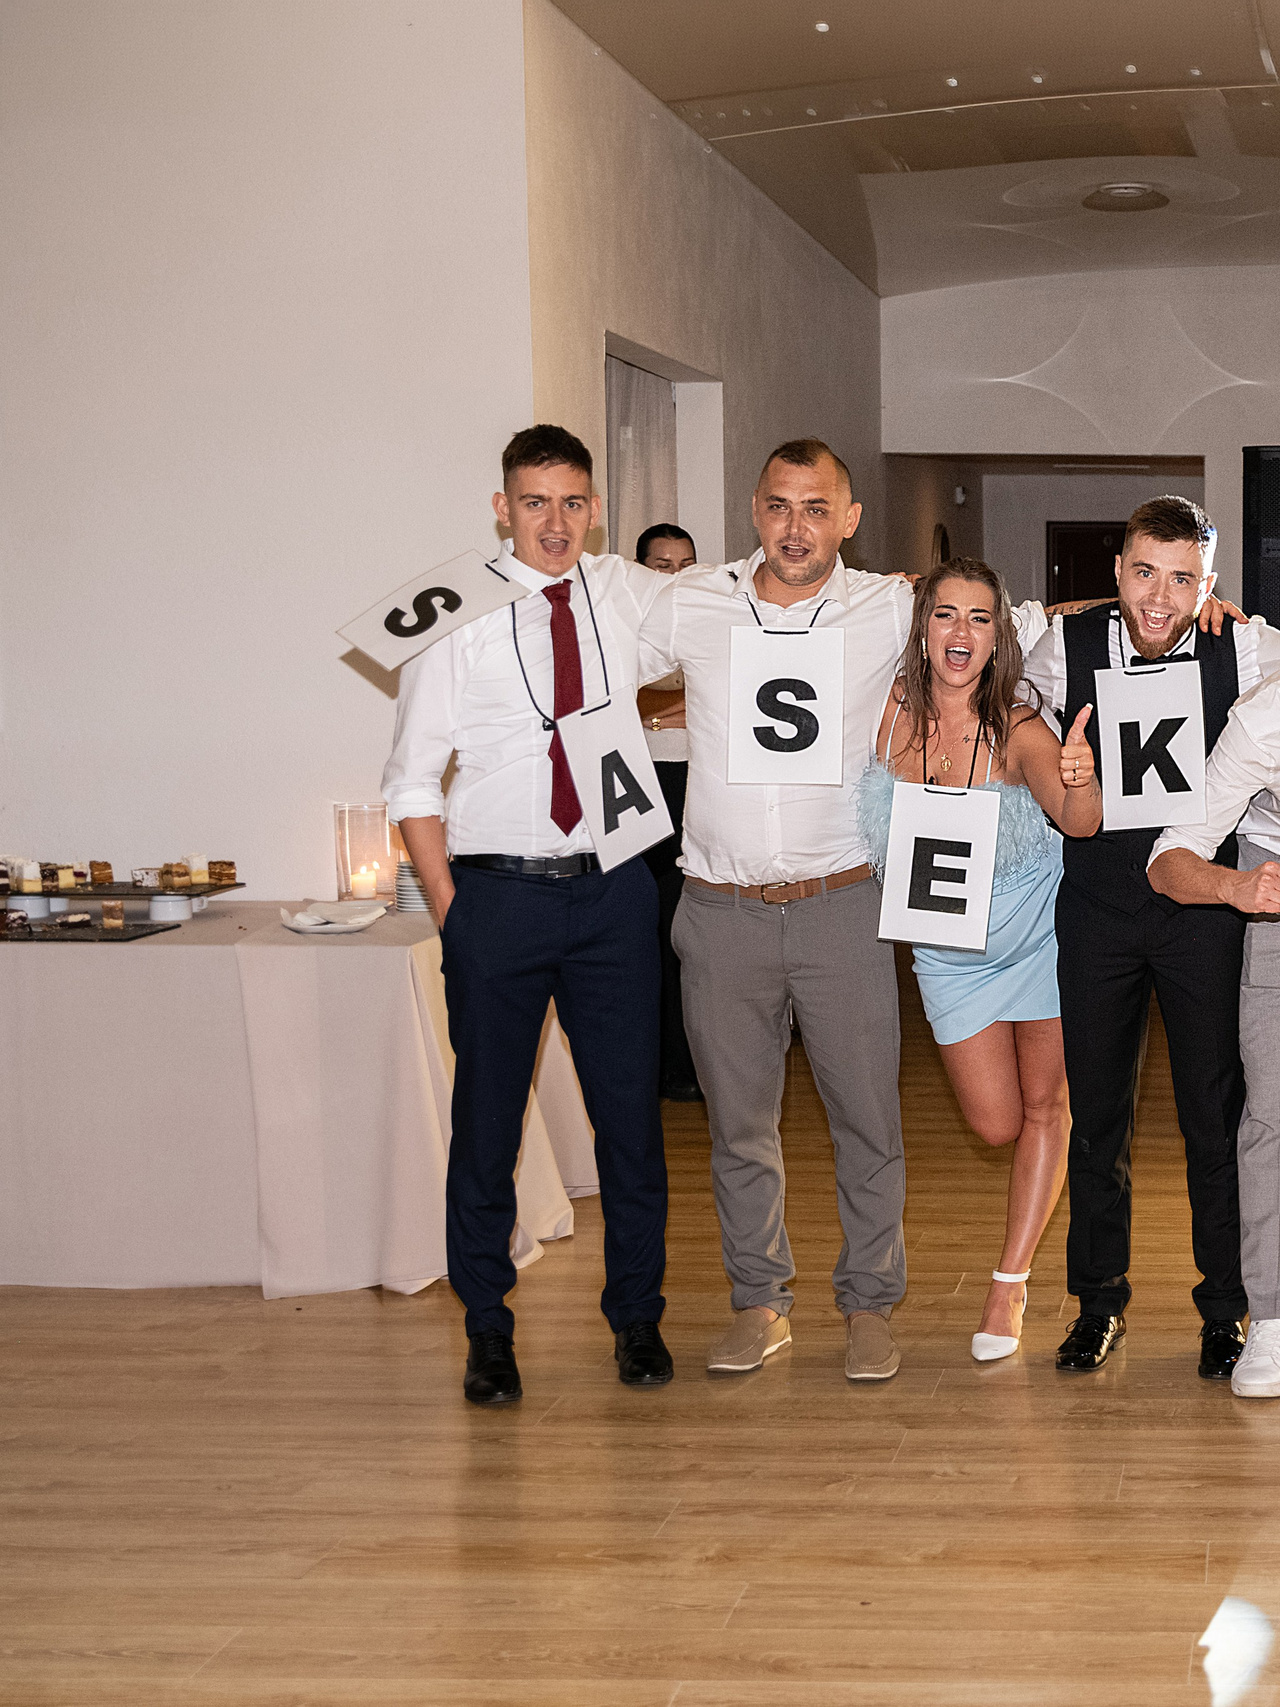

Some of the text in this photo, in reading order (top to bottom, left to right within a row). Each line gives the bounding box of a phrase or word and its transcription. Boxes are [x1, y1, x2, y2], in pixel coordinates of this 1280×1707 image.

[384, 587, 462, 637] S
[753, 679, 819, 752] S
[602, 750, 654, 835] A
[1119, 717, 1192, 796] K
[908, 837, 972, 915] E
